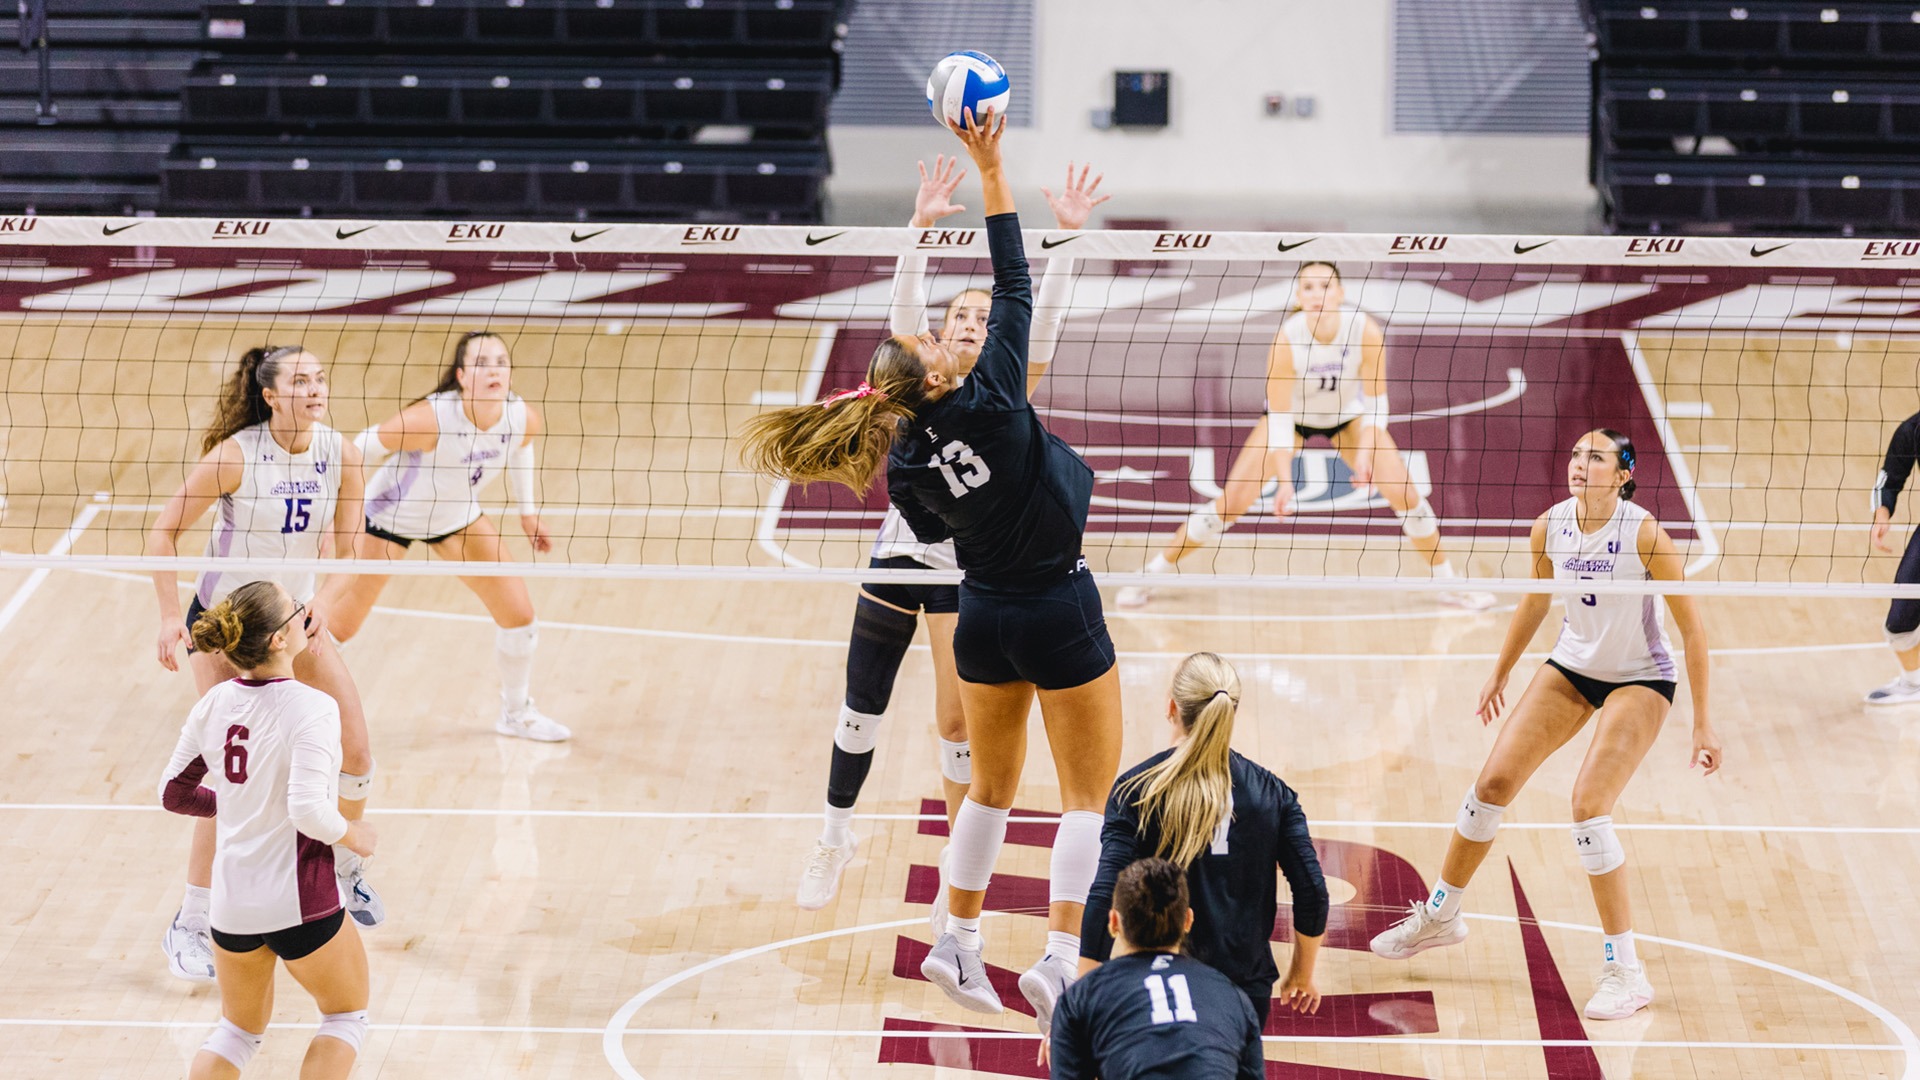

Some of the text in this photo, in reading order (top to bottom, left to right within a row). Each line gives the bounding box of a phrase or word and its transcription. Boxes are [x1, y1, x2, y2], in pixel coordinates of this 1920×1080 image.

[0, 218, 38, 231] KU
[214, 221, 270, 235] EKU
[448, 224, 505, 238] EKU
[684, 227, 740, 241] EKU
[919, 230, 976, 245] EKU
[1154, 234, 1212, 248] EKU
[1391, 236, 1448, 250] EKU
[1626, 239, 1685, 253] EKU
[1863, 242, 1920, 256] EKU
[1318, 375, 1337, 391] 11
[928, 440, 991, 499] 13
[281, 498, 312, 533] 15
[224, 724, 249, 784] 6
[1144, 974, 1197, 1025] 11
